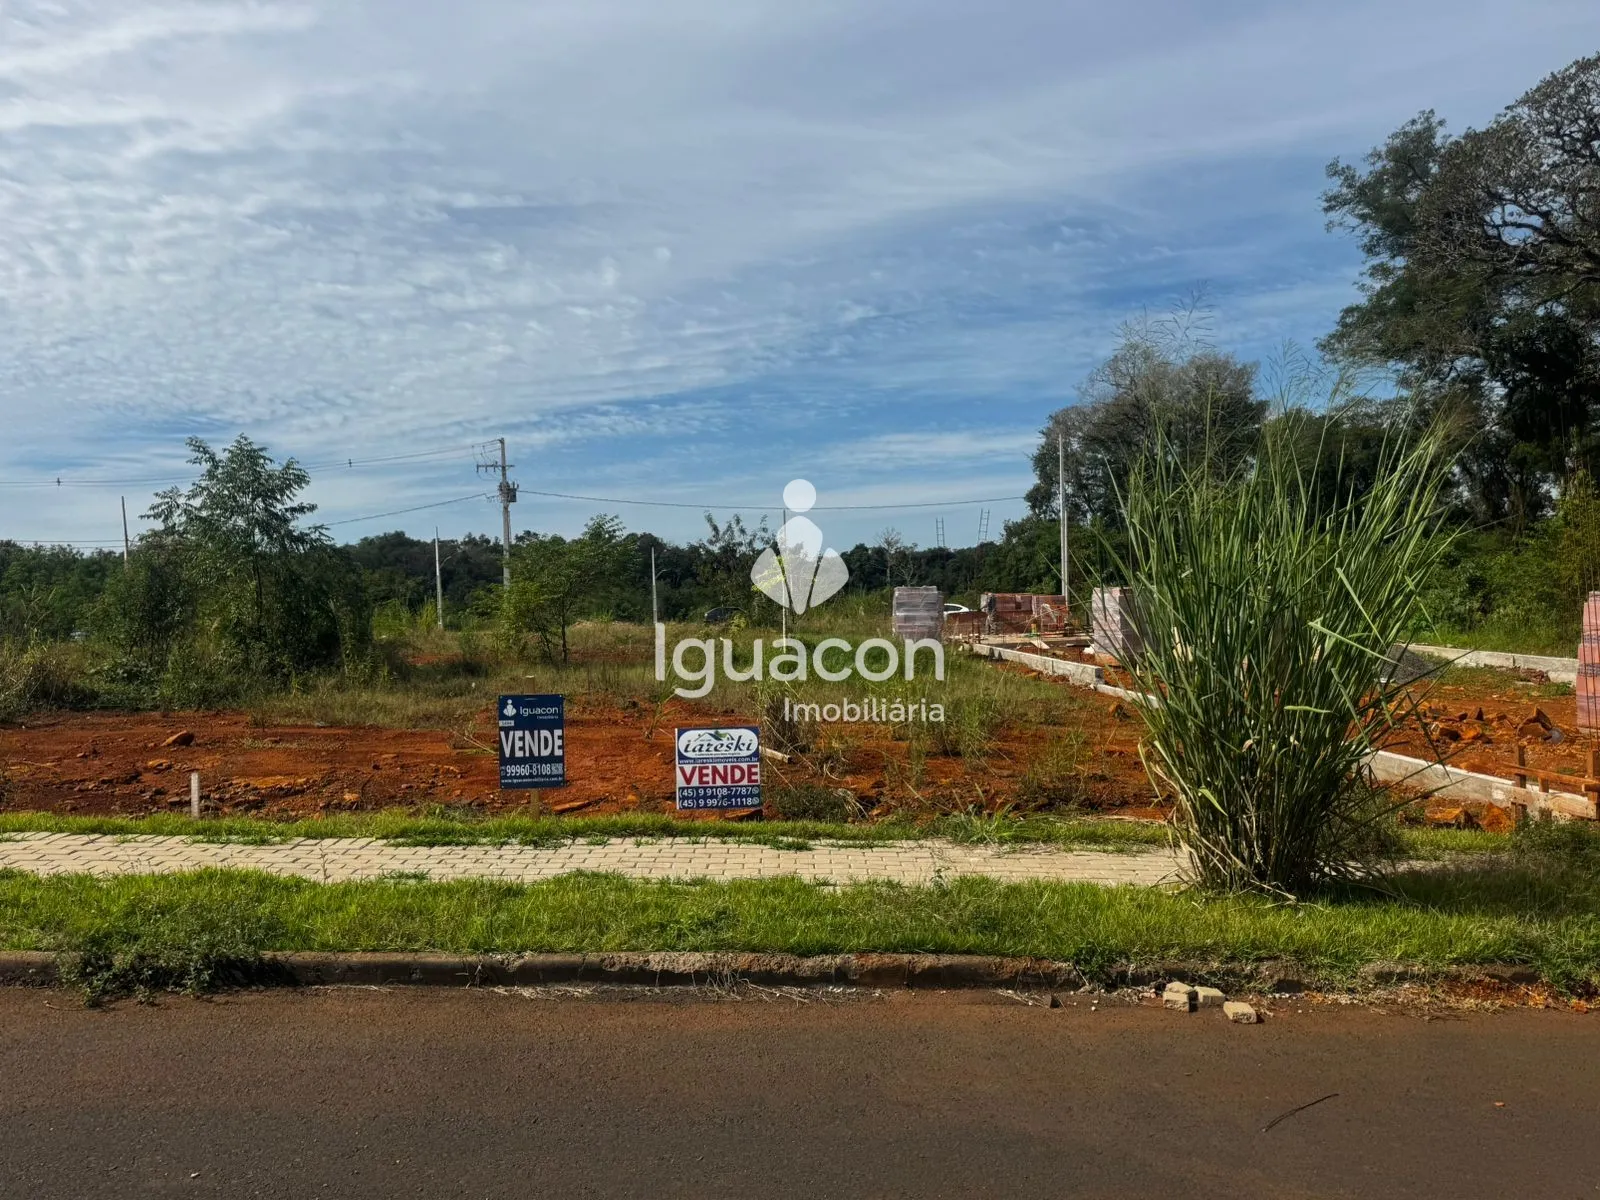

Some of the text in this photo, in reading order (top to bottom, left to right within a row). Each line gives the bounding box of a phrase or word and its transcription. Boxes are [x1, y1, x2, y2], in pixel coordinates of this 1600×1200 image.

[519, 706, 559, 716] Iguacon
[500, 729, 563, 758] VENDE
[506, 764, 551, 776] 99960-8108
[678, 764, 759, 786] VENDE
[679, 786, 752, 798] (45) 9 9108-7787
[679, 799, 697, 809] (45)
[698, 798, 705, 807] 9
